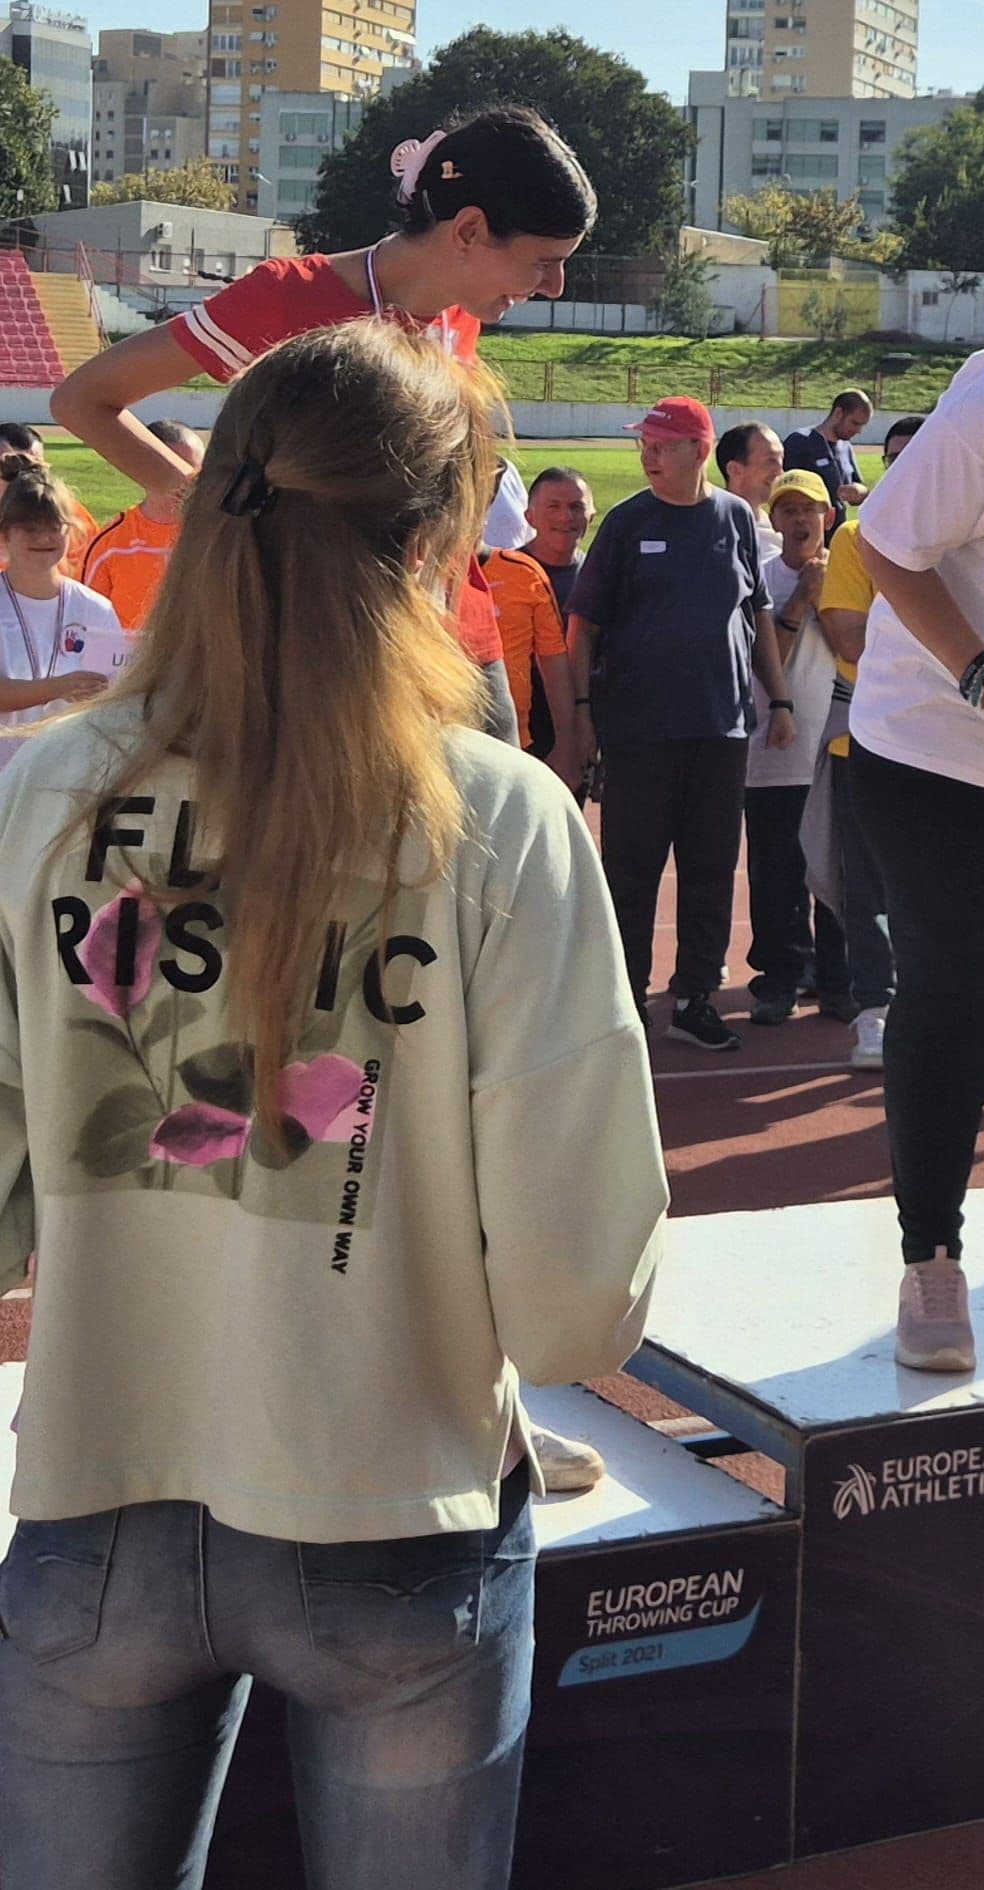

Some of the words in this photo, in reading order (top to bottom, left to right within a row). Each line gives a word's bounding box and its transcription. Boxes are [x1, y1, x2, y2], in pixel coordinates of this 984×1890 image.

[357, 1058, 381, 1116] GROW
[346, 1122, 369, 1175] YOUR
[338, 1179, 361, 1226] OWN
[331, 1231, 353, 1275] WAY
[586, 1567, 745, 1617] EUROPEAN
[586, 1603, 693, 1639] THROWING
[699, 1596, 740, 1620] CUP
[578, 1651, 618, 1674] Split
[621, 1642, 664, 1665] 2021
